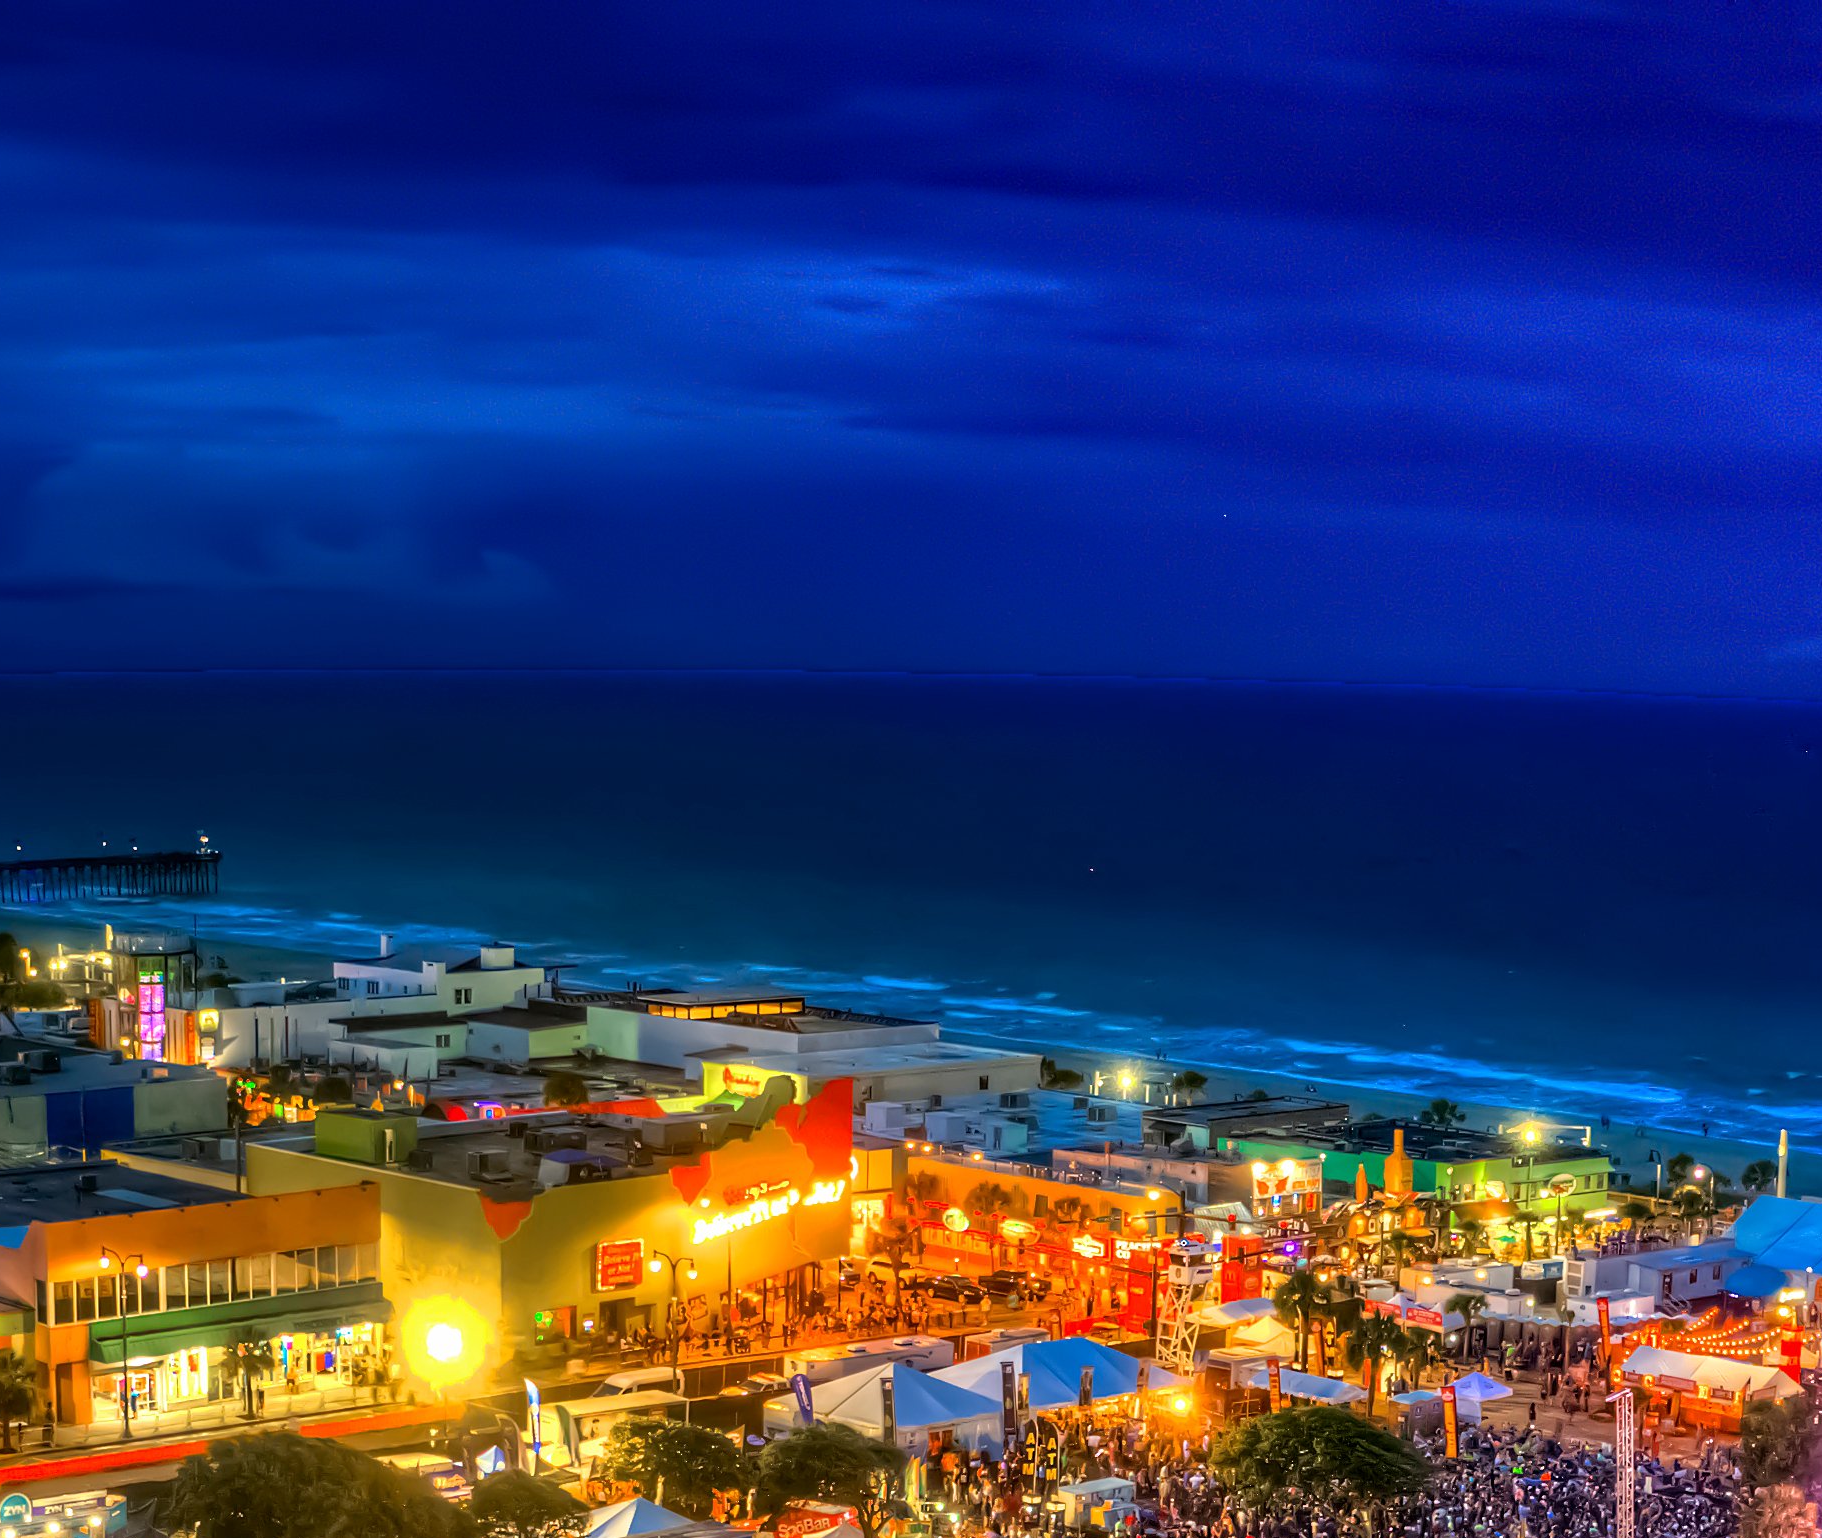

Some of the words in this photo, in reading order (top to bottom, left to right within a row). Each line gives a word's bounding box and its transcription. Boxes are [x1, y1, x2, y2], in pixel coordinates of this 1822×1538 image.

[1022, 1432, 1036, 1475] ATM
[1045, 1437, 1057, 1480] ATM
[3, 1504, 26, 1517] ZYN
[44, 1504, 63, 1515] ZYN
